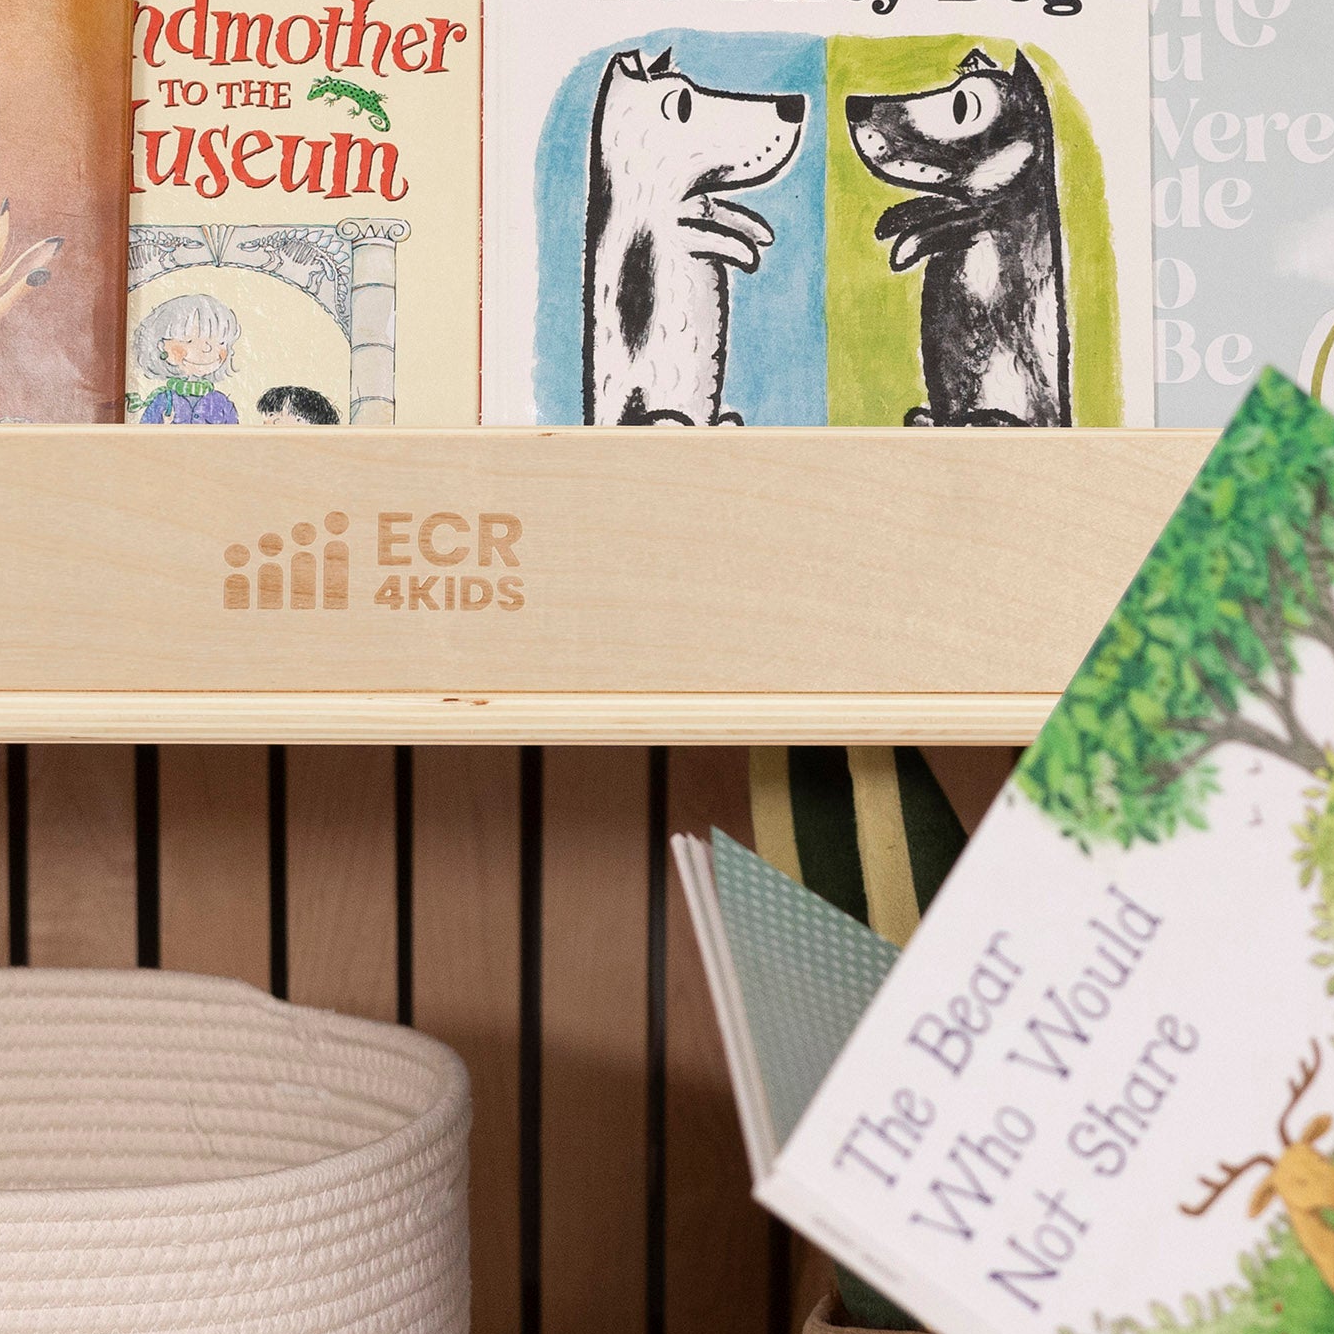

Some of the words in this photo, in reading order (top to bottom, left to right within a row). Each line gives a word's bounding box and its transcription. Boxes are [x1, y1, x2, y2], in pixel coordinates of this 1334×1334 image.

[158, 79, 208, 108] TO
[217, 79, 292, 110] THE
[130, 99, 410, 202] useum
[1152, 165, 1254, 229] de
[1153, 318, 1254, 386] Be
[377, 512, 523, 567] ECR
[373, 575, 525, 612] 4KIDS
[833, 1087, 937, 1187] The
[907, 929, 1027, 1077] Bear
[909, 1105, 1037, 1243] Who
[1005, 882, 1164, 1081] Would
[989, 1188, 1092, 1313] Not
[1067, 1013, 1200, 1179] Share
